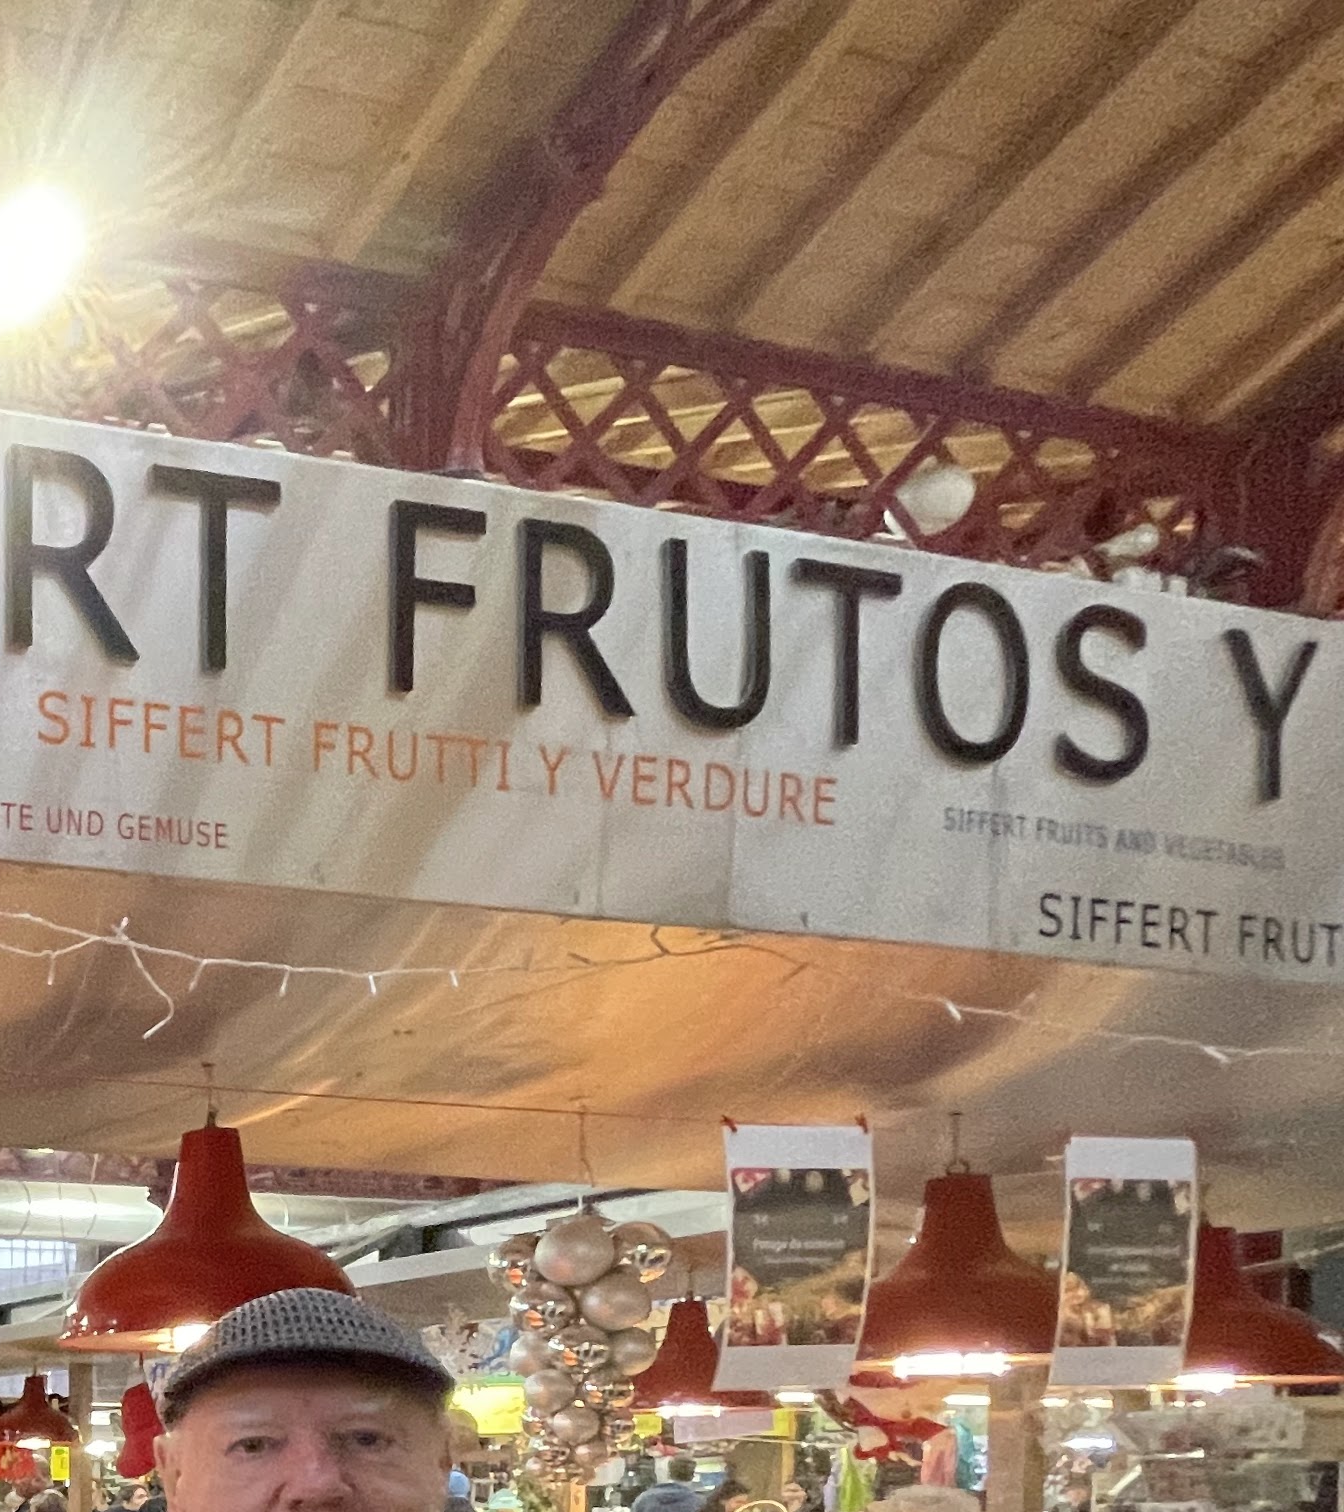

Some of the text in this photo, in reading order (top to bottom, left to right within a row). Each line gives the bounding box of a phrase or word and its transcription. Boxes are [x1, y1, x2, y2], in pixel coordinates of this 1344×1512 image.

[387, 498, 1151, 786] FRUTOS
[1221, 627, 1320, 803] Y
[37, 689, 838, 827] SIFFERT FRUTTI Y VERDURE
[47, 806, 104, 837] UND
[117, 813, 229, 850] GEMUSE
[942, 806, 1026, 842] SIFFERT
[1035, 815, 1109, 849] FRUITS
[1115, 827, 1157, 856] AND
[1038, 892, 1218, 955] SIFFERT
